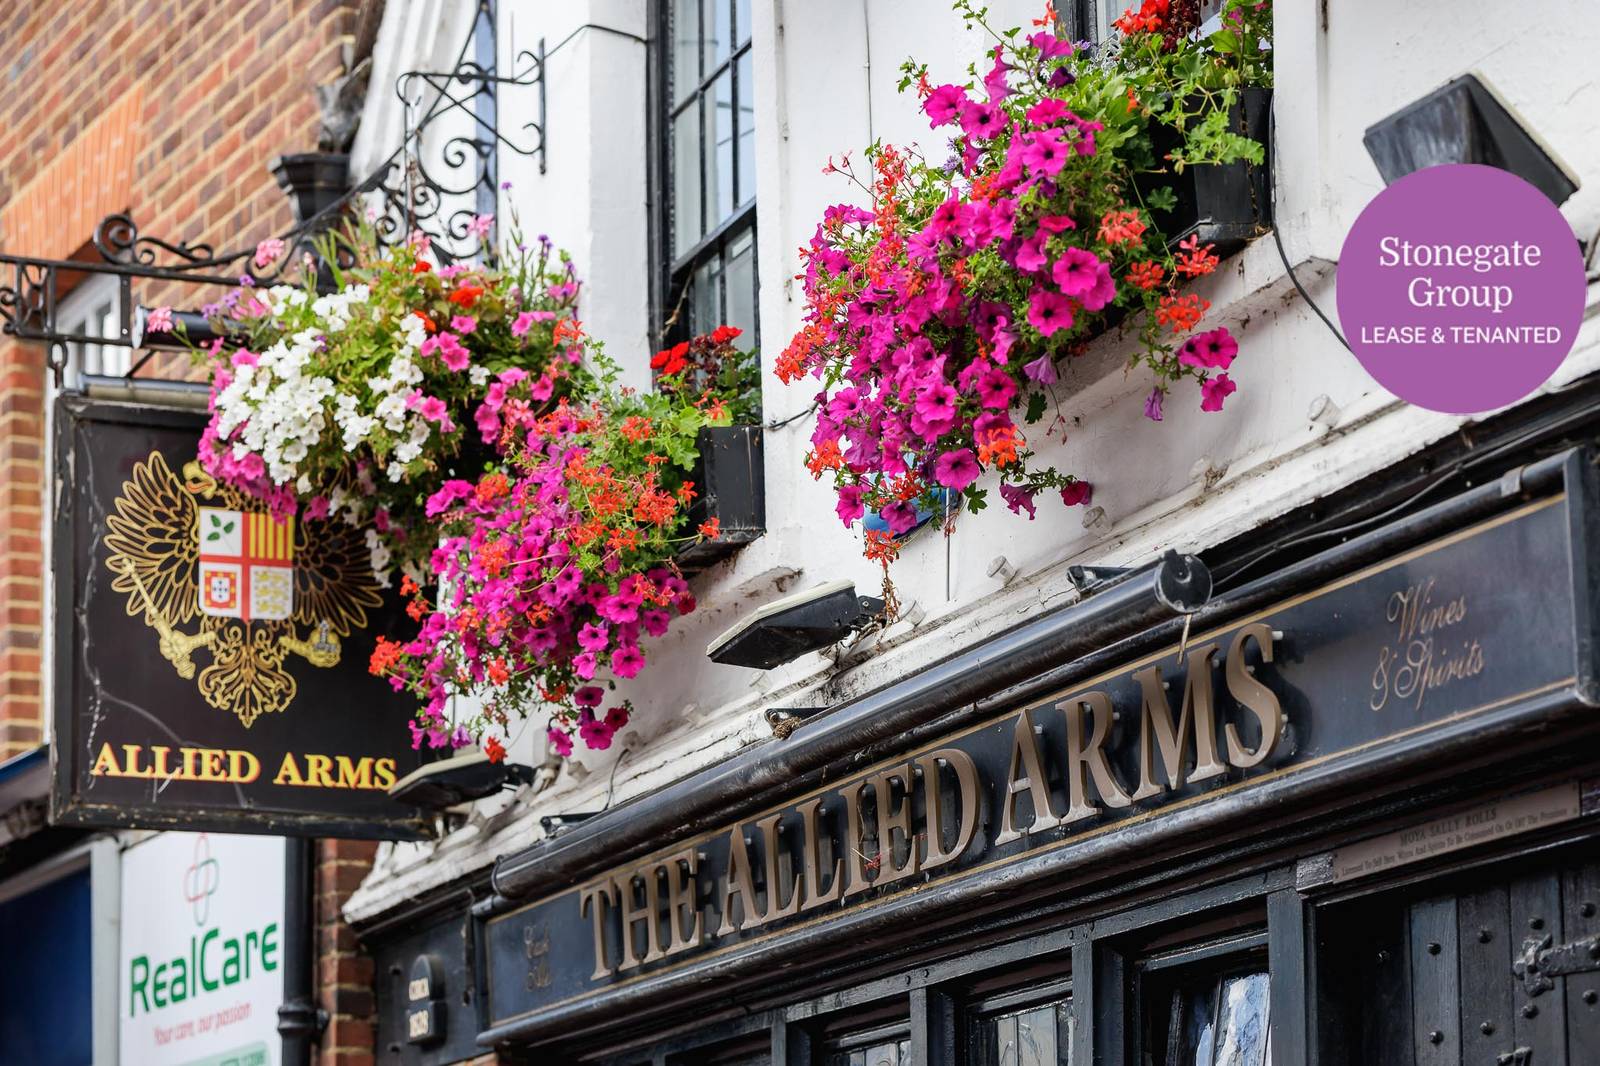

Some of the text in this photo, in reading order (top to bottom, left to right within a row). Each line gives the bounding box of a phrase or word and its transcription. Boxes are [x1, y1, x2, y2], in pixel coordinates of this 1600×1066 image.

[1386, 576, 1466, 643] Wines
[1394, 638, 1484, 710] Spirits
[89, 742, 401, 791] ALLIED ARMS
[580, 623, 1284, 981] THE ALLIED ARMS
[1465, 807, 1497, 827] ROLLS
[131, 923, 277, 1018] RealCare
